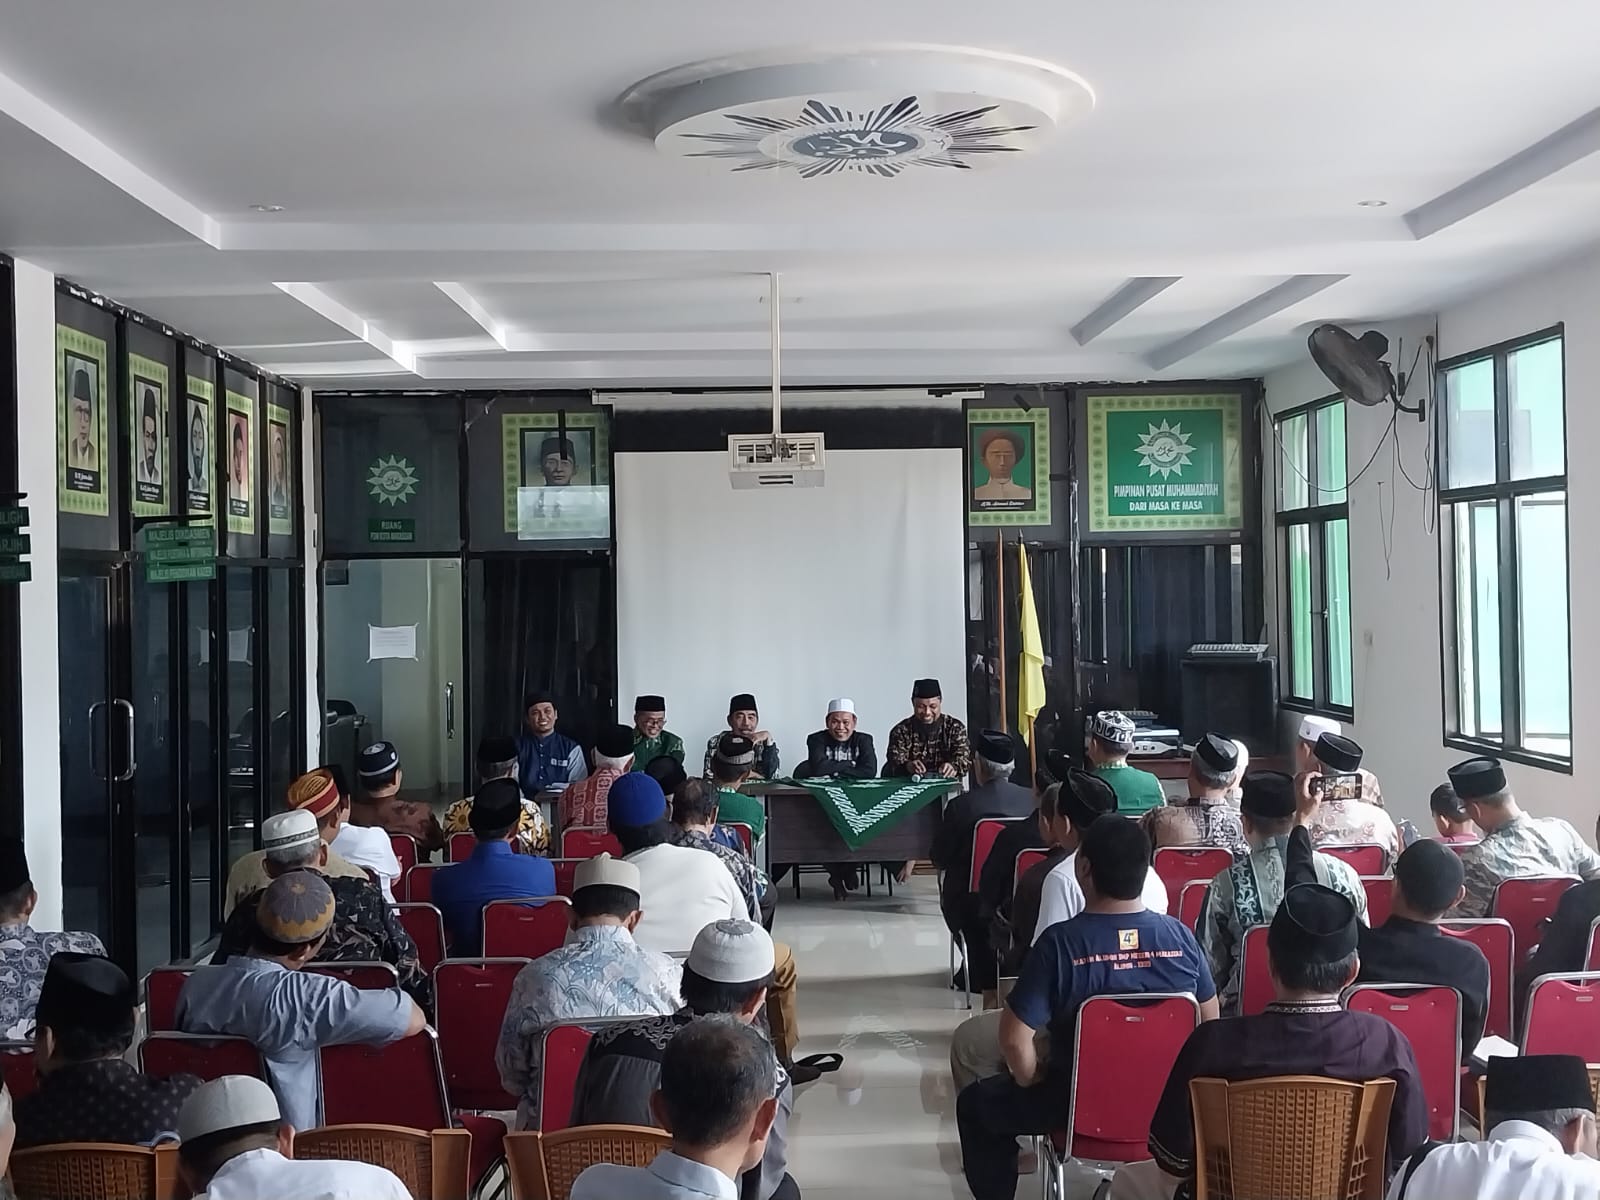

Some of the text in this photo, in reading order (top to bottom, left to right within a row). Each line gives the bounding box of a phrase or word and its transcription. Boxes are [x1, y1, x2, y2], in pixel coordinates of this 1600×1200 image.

[1114, 483, 1219, 497] PIMPINAN PUSAT MUHAMMADIYAH
[1129, 501, 1202, 511] DARI MASA KE MASA
[0, 510, 24, 525] LIGH
[0, 537, 24, 552] RJIH
